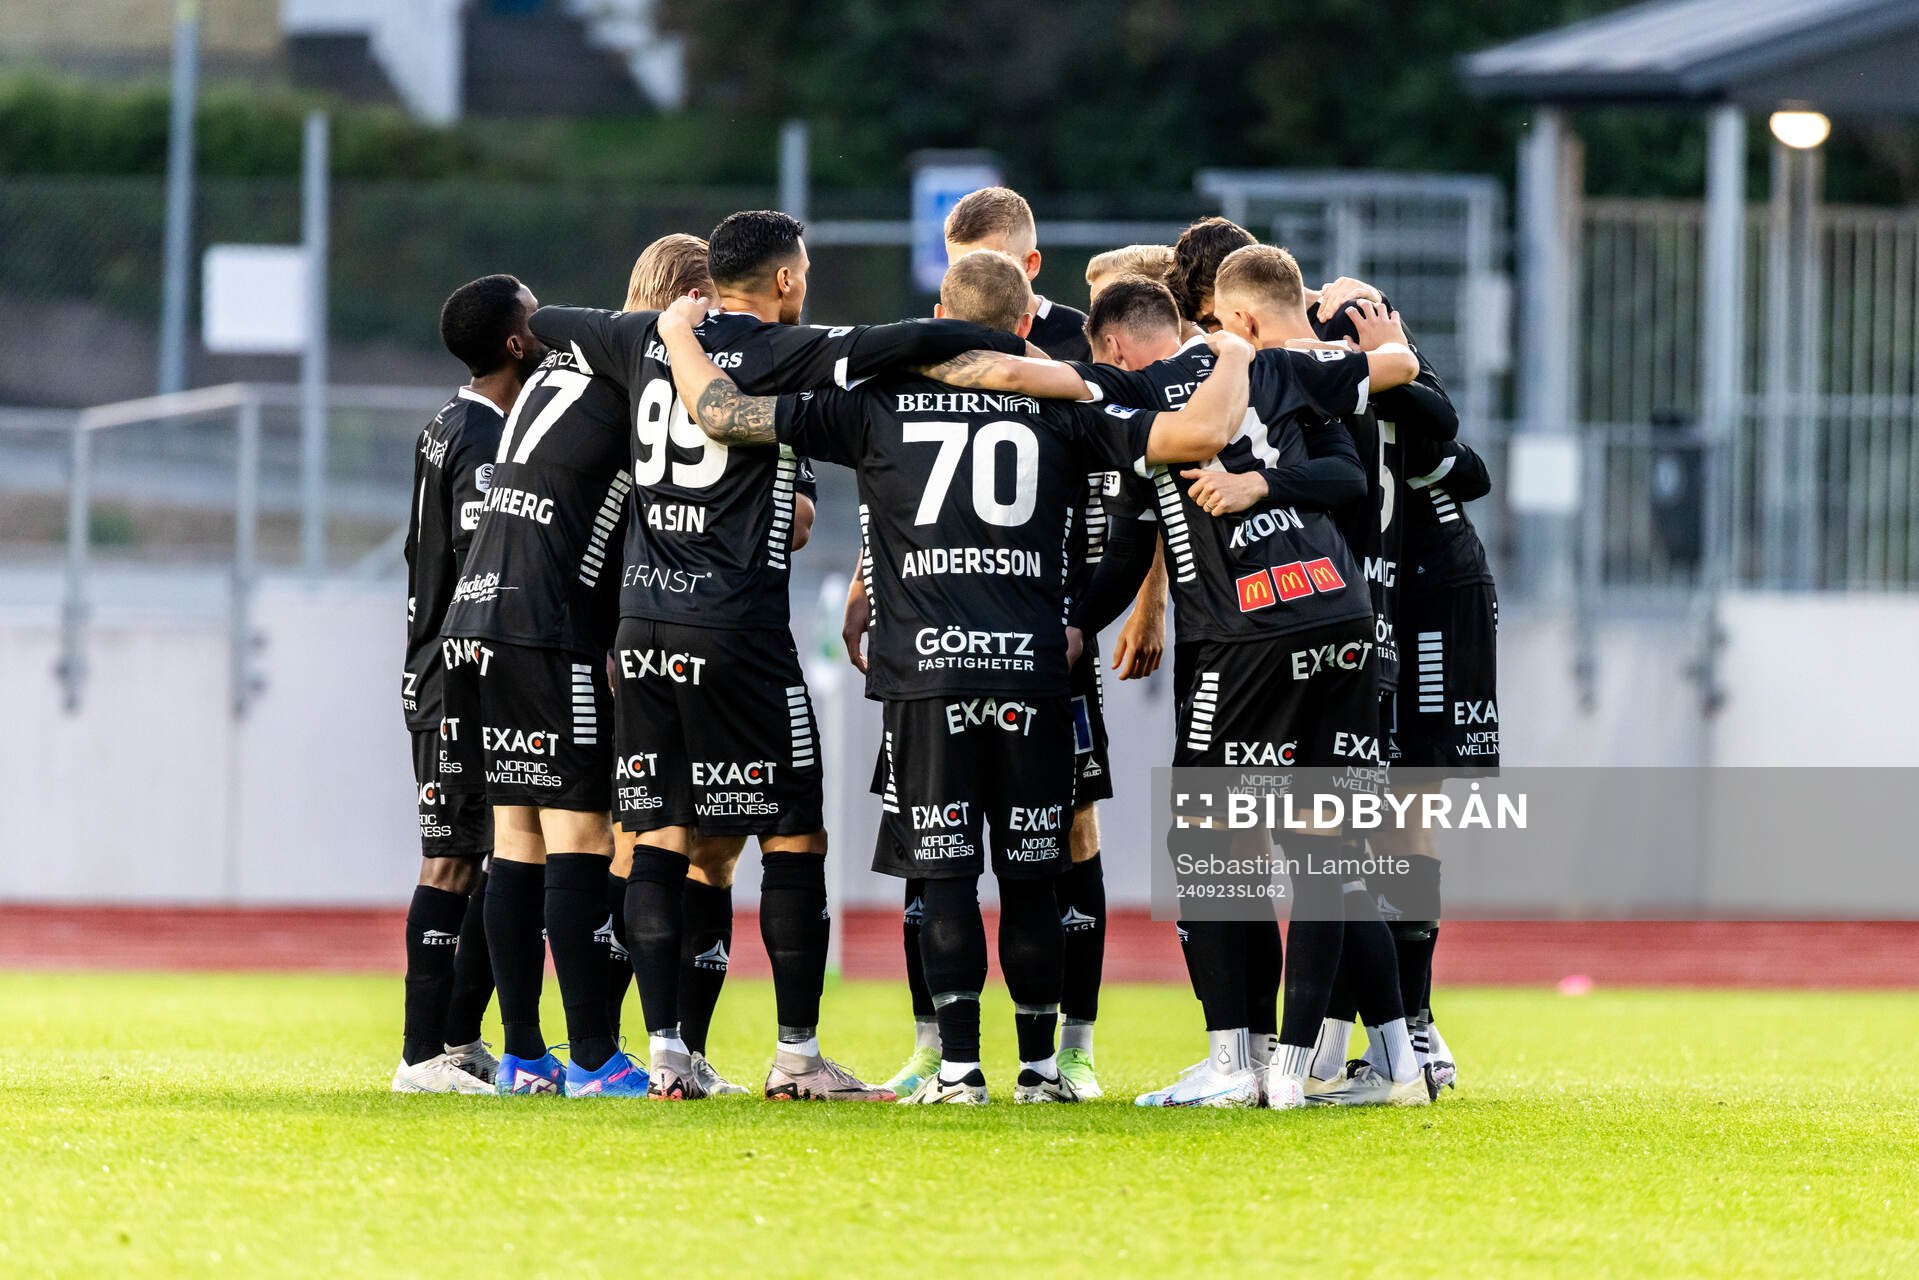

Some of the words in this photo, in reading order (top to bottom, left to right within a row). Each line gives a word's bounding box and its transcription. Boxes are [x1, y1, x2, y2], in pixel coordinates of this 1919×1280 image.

[896, 393, 1004, 413] BEHRN
[495, 369, 592, 465] 17
[902, 421, 1039, 527] 70
[482, 487, 554, 525] LMBERG
[643, 503, 706, 533] ASIN
[1229, 506, 1304, 549] KROON
[902, 547, 1041, 579] ANDERSSON
[915, 625, 1034, 656] GÖRTZ
[918, 657, 1034, 671] FASTIGHETER
[945, 697, 1038, 737] EXACT
[1454, 700, 1499, 725] EXA
[482, 726, 559, 757] EXACT
[1225, 741, 1298, 766] EXAC
[1333, 731, 1379, 762] EXA
[496, 759, 548, 775] NORDIC
[616, 752, 658, 780] ACT
[692, 760, 777, 786] EXACT
[485, 770, 562, 788] WELLNESS
[618, 786, 648, 799] RDIC
[620, 797, 663, 811] LNESS
[706, 792, 764, 804] NORDIC
[695, 803, 779, 816] WELLNESS
[911, 800, 971, 830] EXACT
[1009, 803, 1062, 831] EXACT
[914, 845, 974, 860] WELLNESS
[921, 833, 965, 848] NORDIC
[1022, 837, 1056, 850] NORDIC
[1006, 848, 1059, 862] WELLNESS
